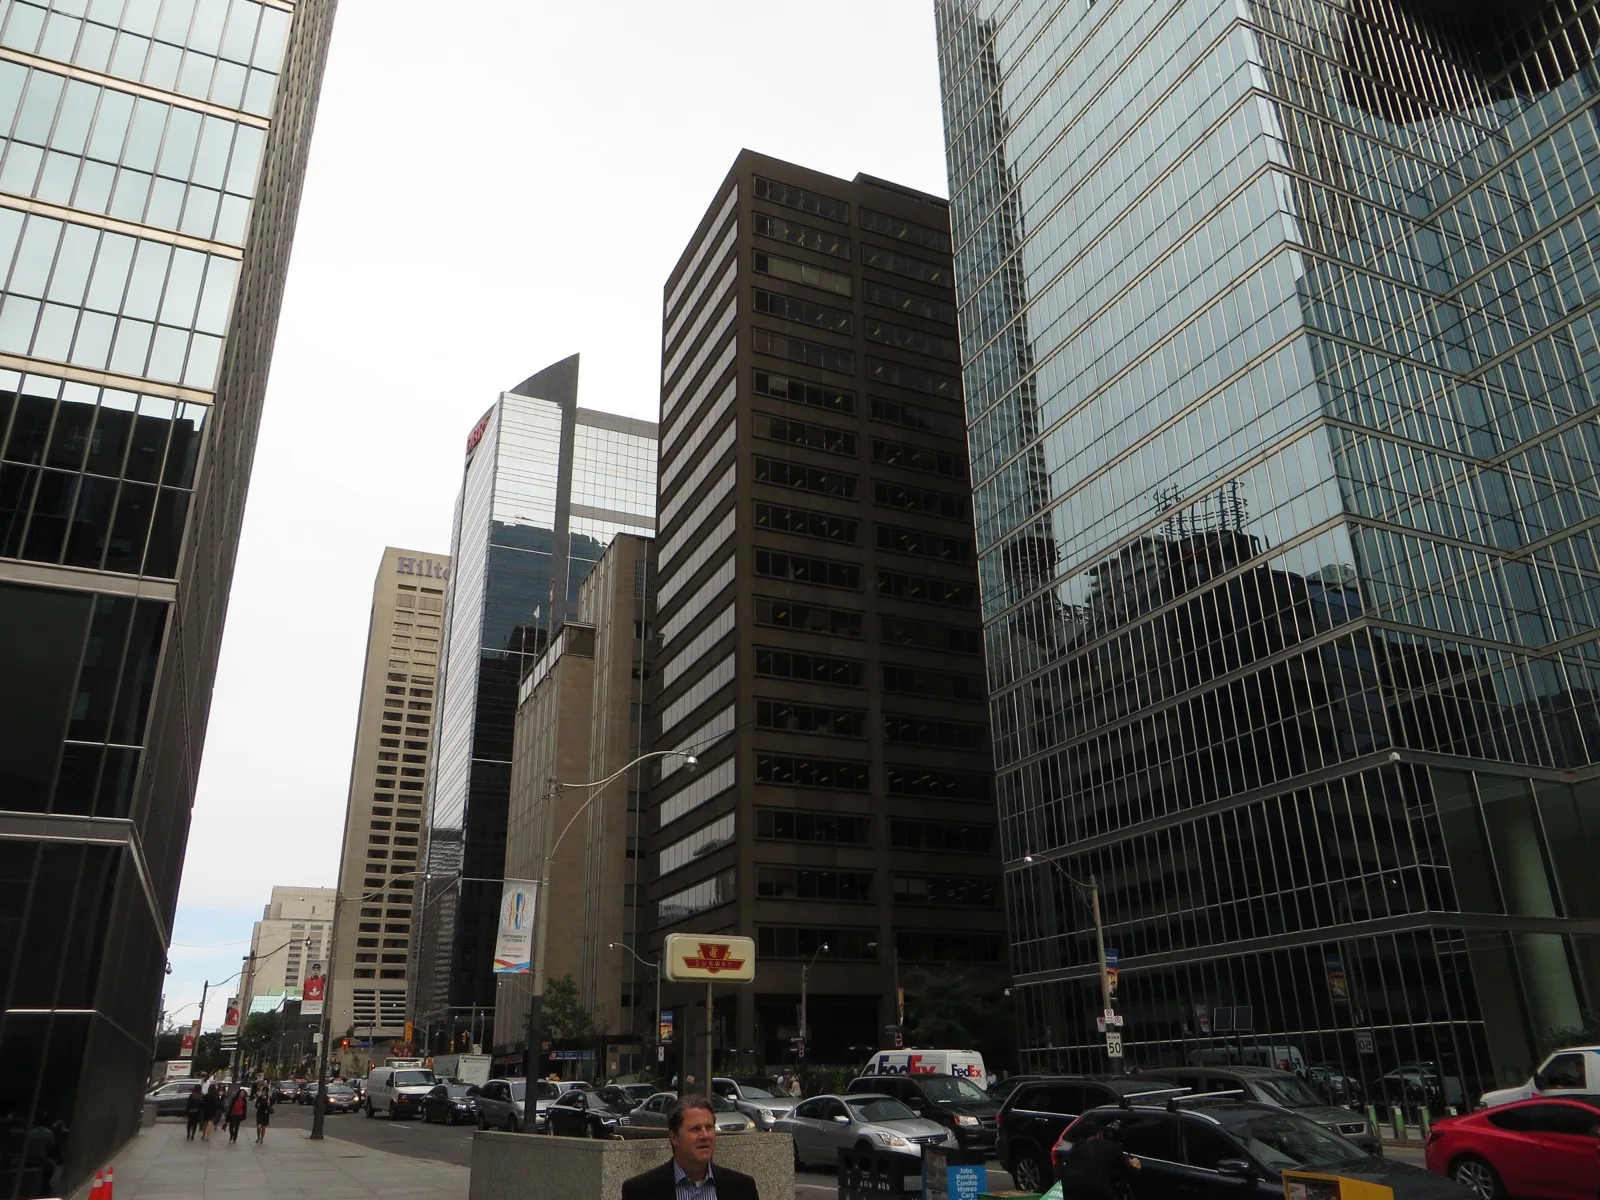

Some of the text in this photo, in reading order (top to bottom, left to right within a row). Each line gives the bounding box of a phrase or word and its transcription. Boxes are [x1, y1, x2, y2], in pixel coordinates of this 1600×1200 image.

[695, 959, 733, 968] SUBWAY
[1108, 1042, 1121, 1054] 50
[951, 1064, 982, 1078] FedEx
